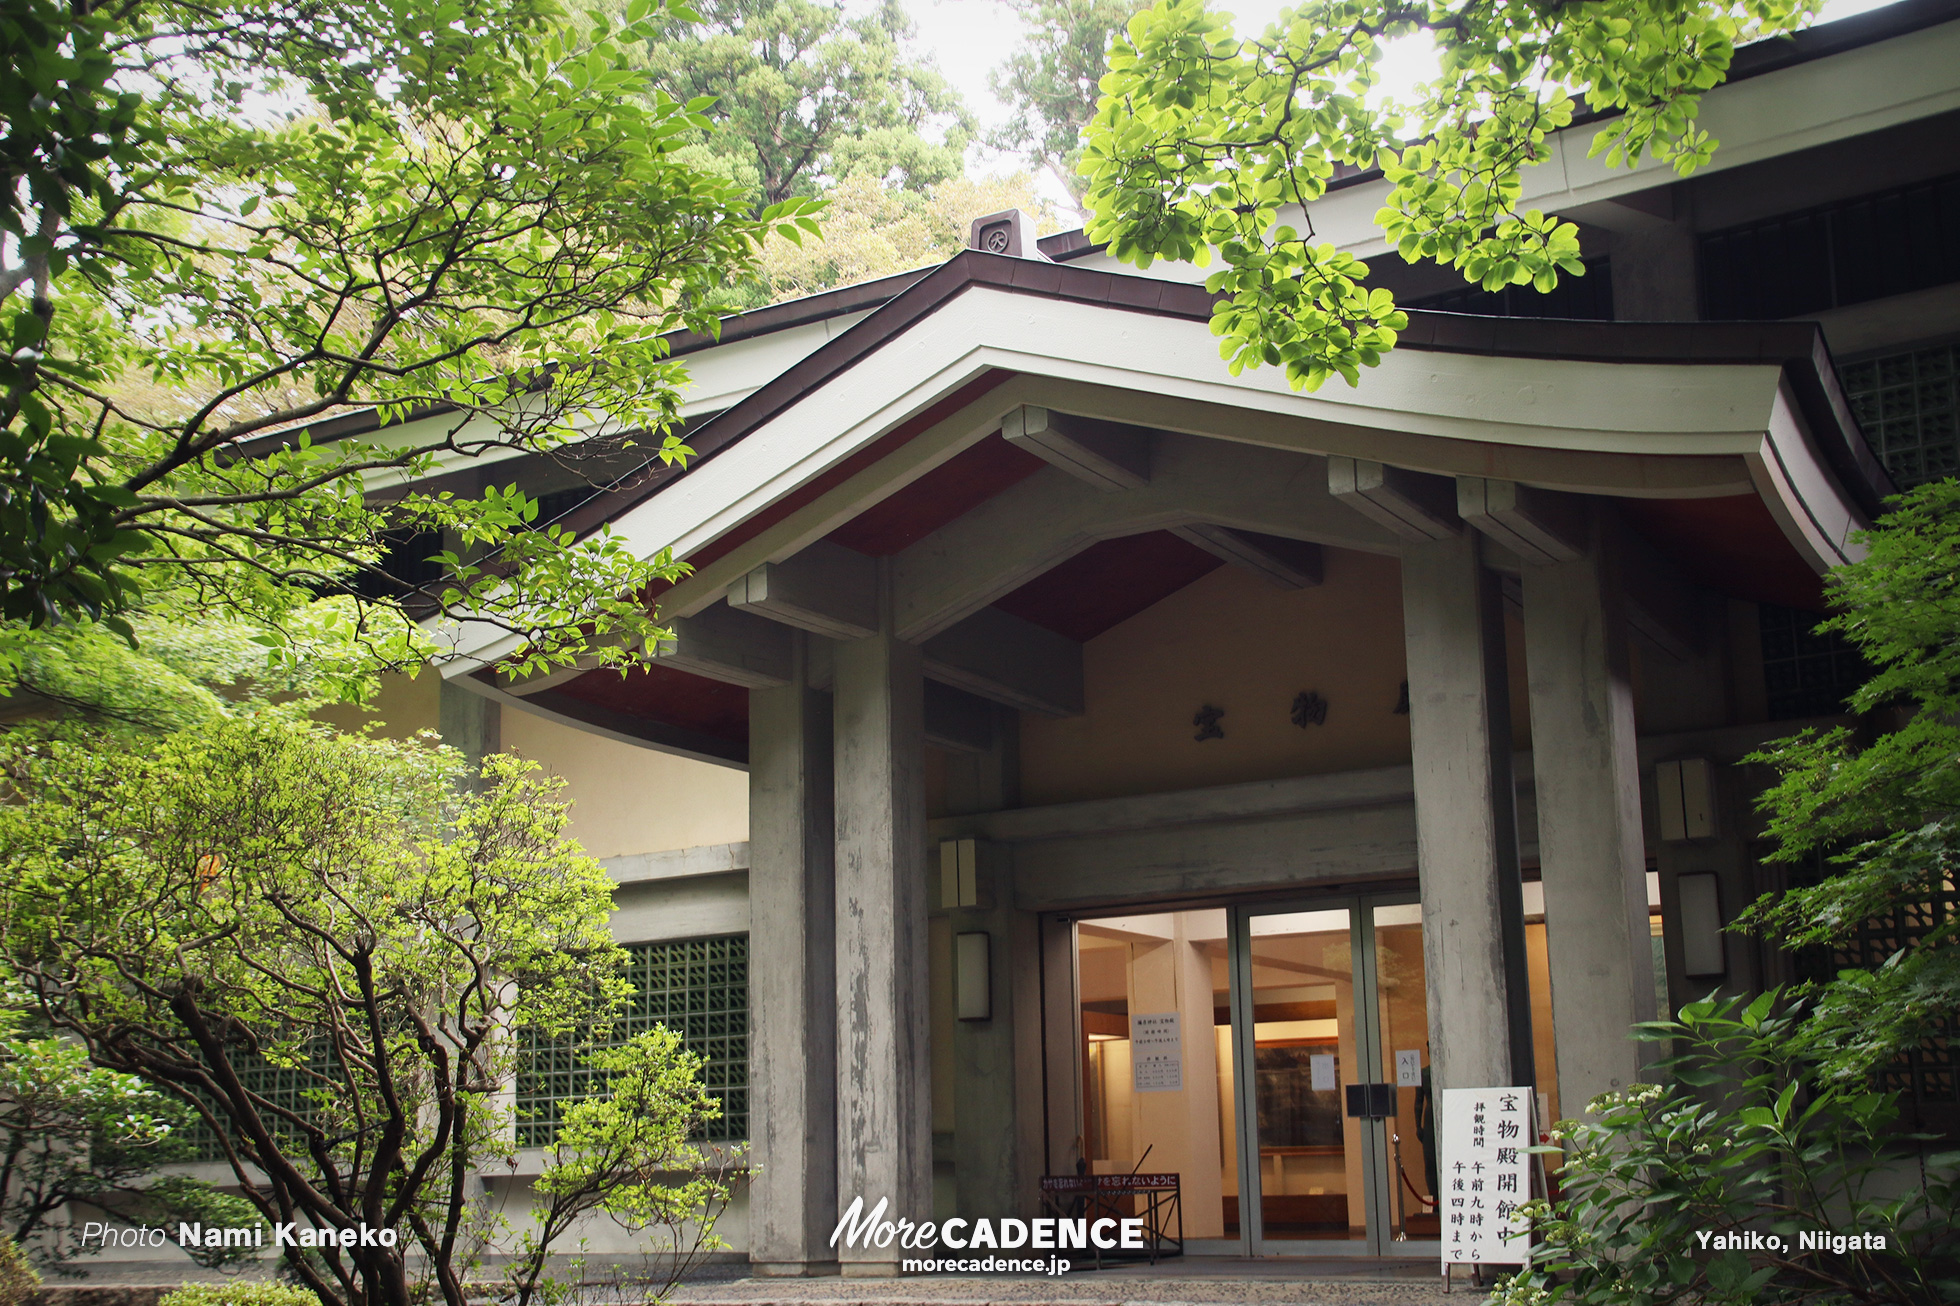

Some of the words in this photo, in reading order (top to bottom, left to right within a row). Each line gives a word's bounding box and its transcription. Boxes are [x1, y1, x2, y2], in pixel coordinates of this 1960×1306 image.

[1402, 1057, 1410, 1080] 入口
[1473, 1101, 1486, 1149] 拝観時間
[1495, 1093, 1520, 1248] 宝物殿開館中
[1450, 1160, 1467, 1260] 午後四時まで
[1470, 1161, 1486, 1261] 午前九時から
